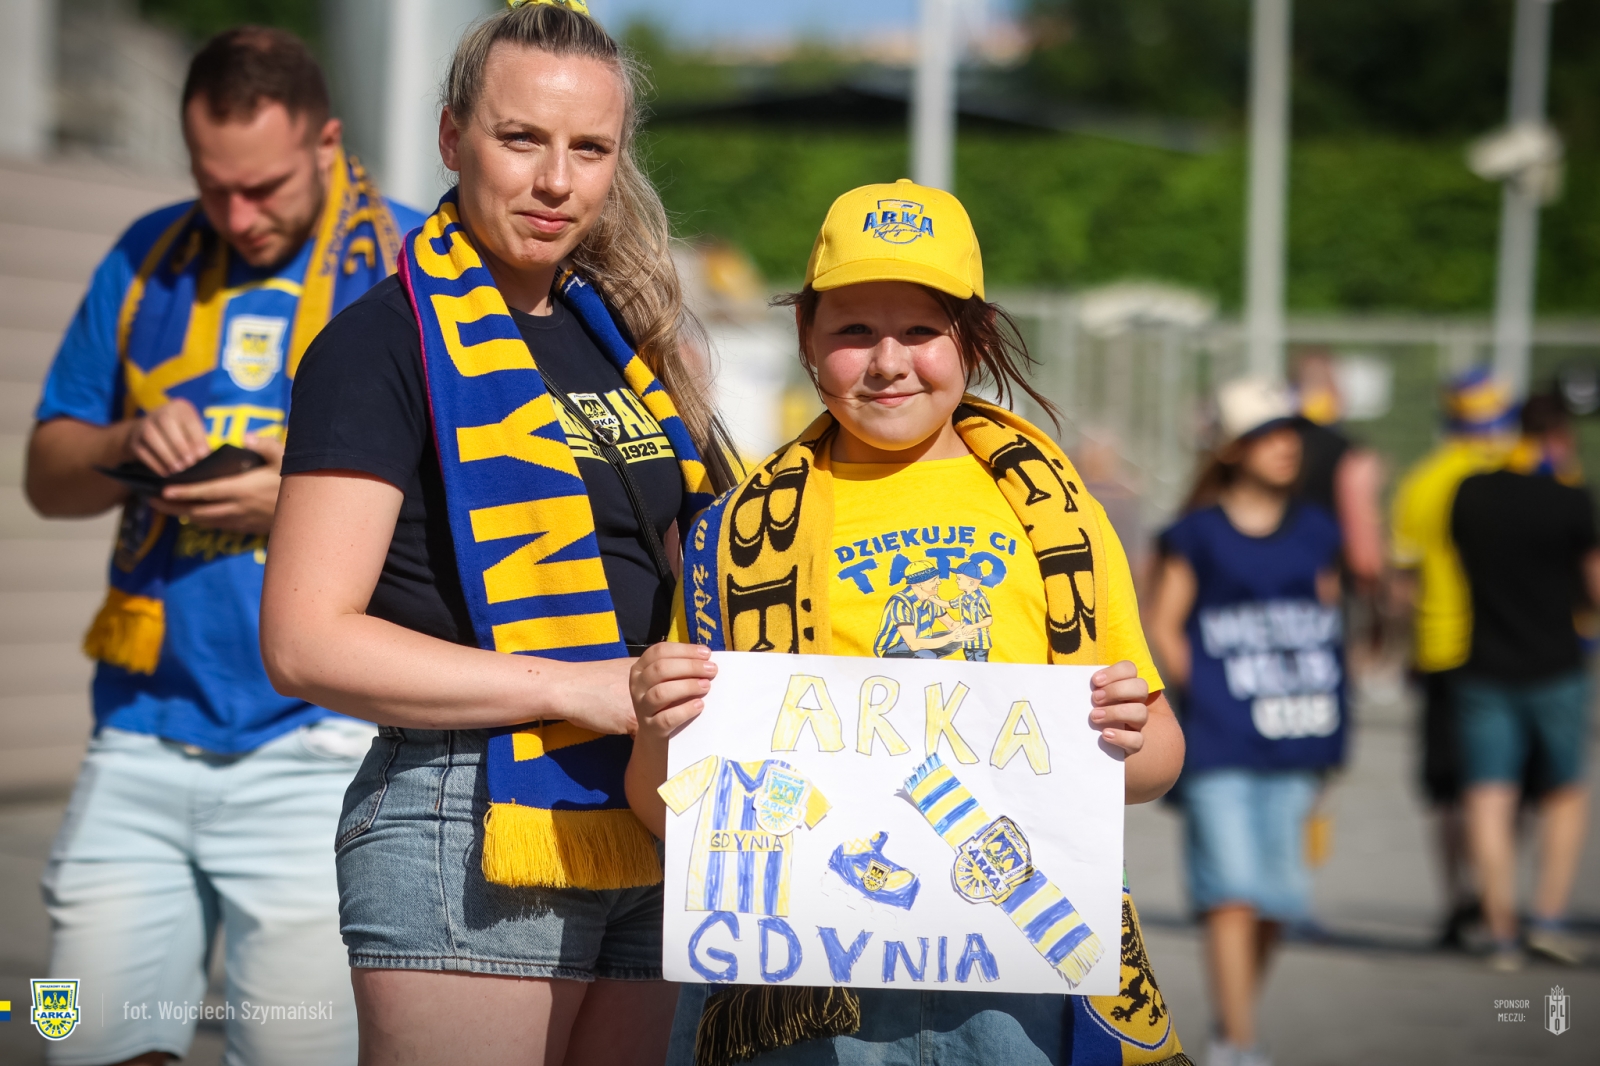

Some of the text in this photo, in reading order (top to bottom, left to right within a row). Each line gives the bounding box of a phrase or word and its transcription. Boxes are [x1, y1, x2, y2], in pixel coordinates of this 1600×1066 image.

[863, 211, 934, 237] ARKA
[592, 417, 613, 427] RKA
[621, 442, 659, 460] 1929
[989, 532, 1017, 556] CI
[771, 674, 1052, 776] ARKA
[762, 799, 794, 816] ARKA
[711, 832, 784, 853] GDYNIA
[968, 849, 1001, 890] ARKA
[688, 911, 1000, 984] GDYNIA
